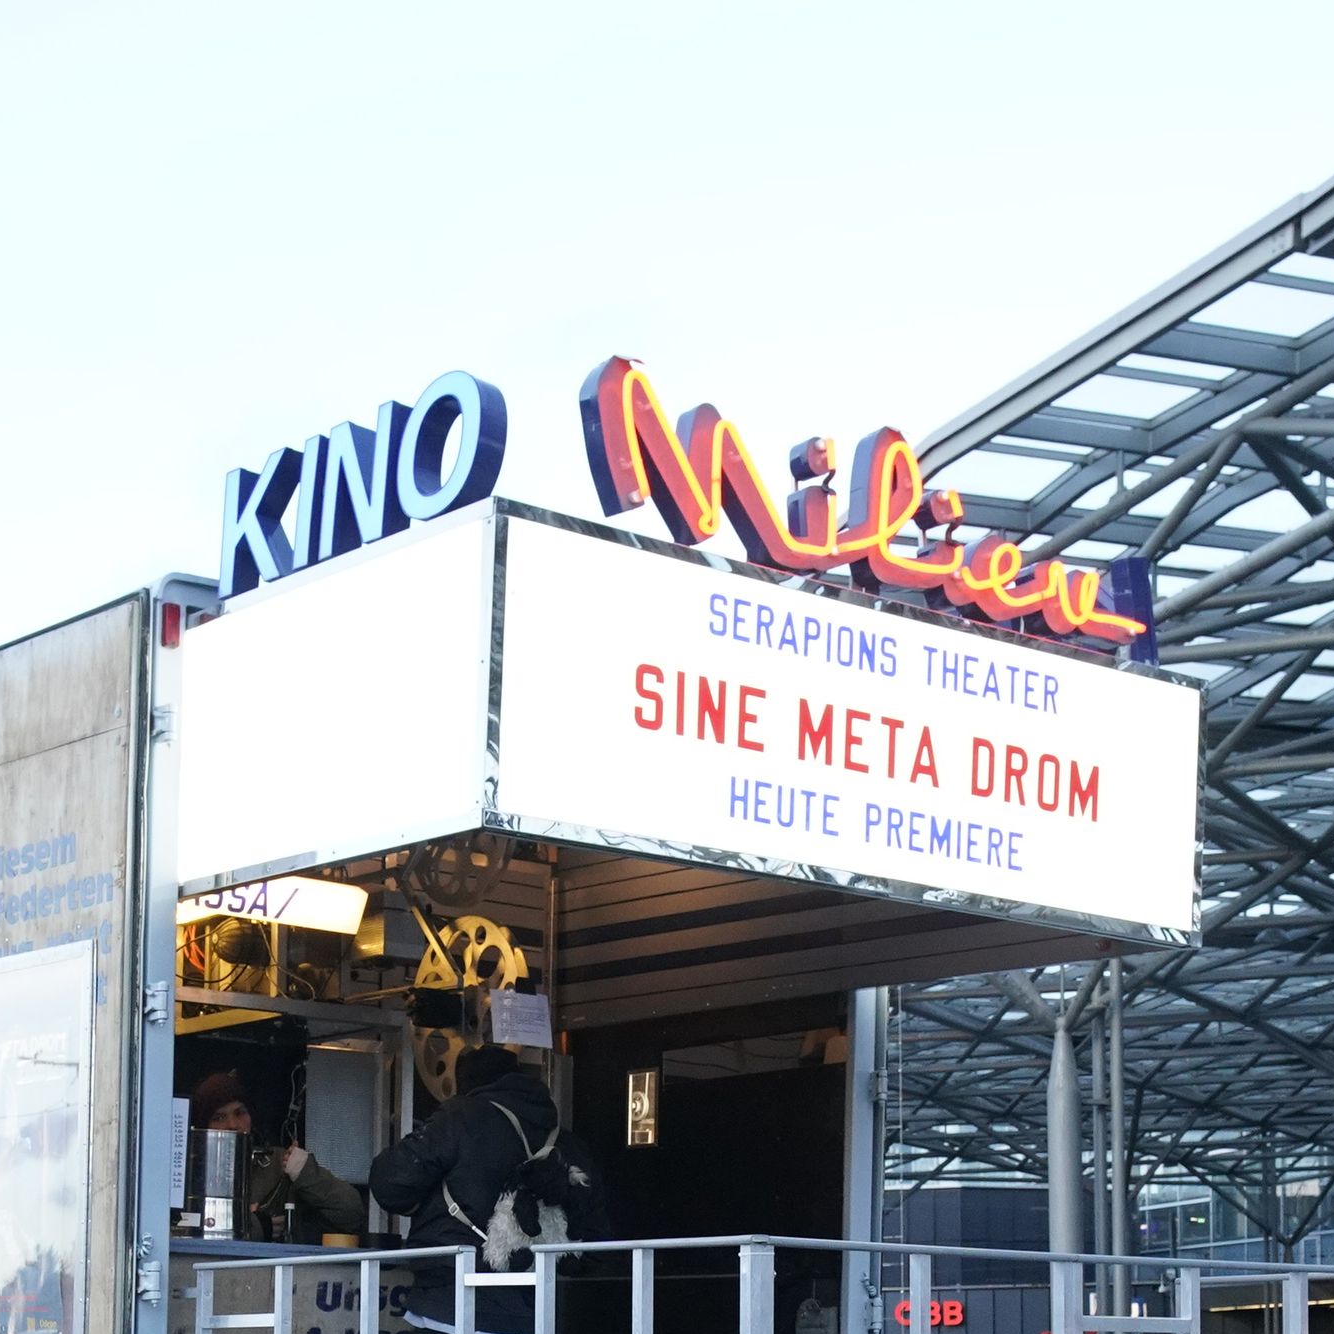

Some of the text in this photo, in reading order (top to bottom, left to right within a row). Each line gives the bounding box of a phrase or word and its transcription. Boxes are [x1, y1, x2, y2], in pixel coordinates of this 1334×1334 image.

[219, 370, 507, 601] KINO
[579, 355, 1147, 646] Milieu
[709, 593, 1060, 714] SERAPIONS THEATER
[634, 663, 1100, 823] SINE META DROM
[729, 776, 1024, 872] HEUTE PREMIERE
